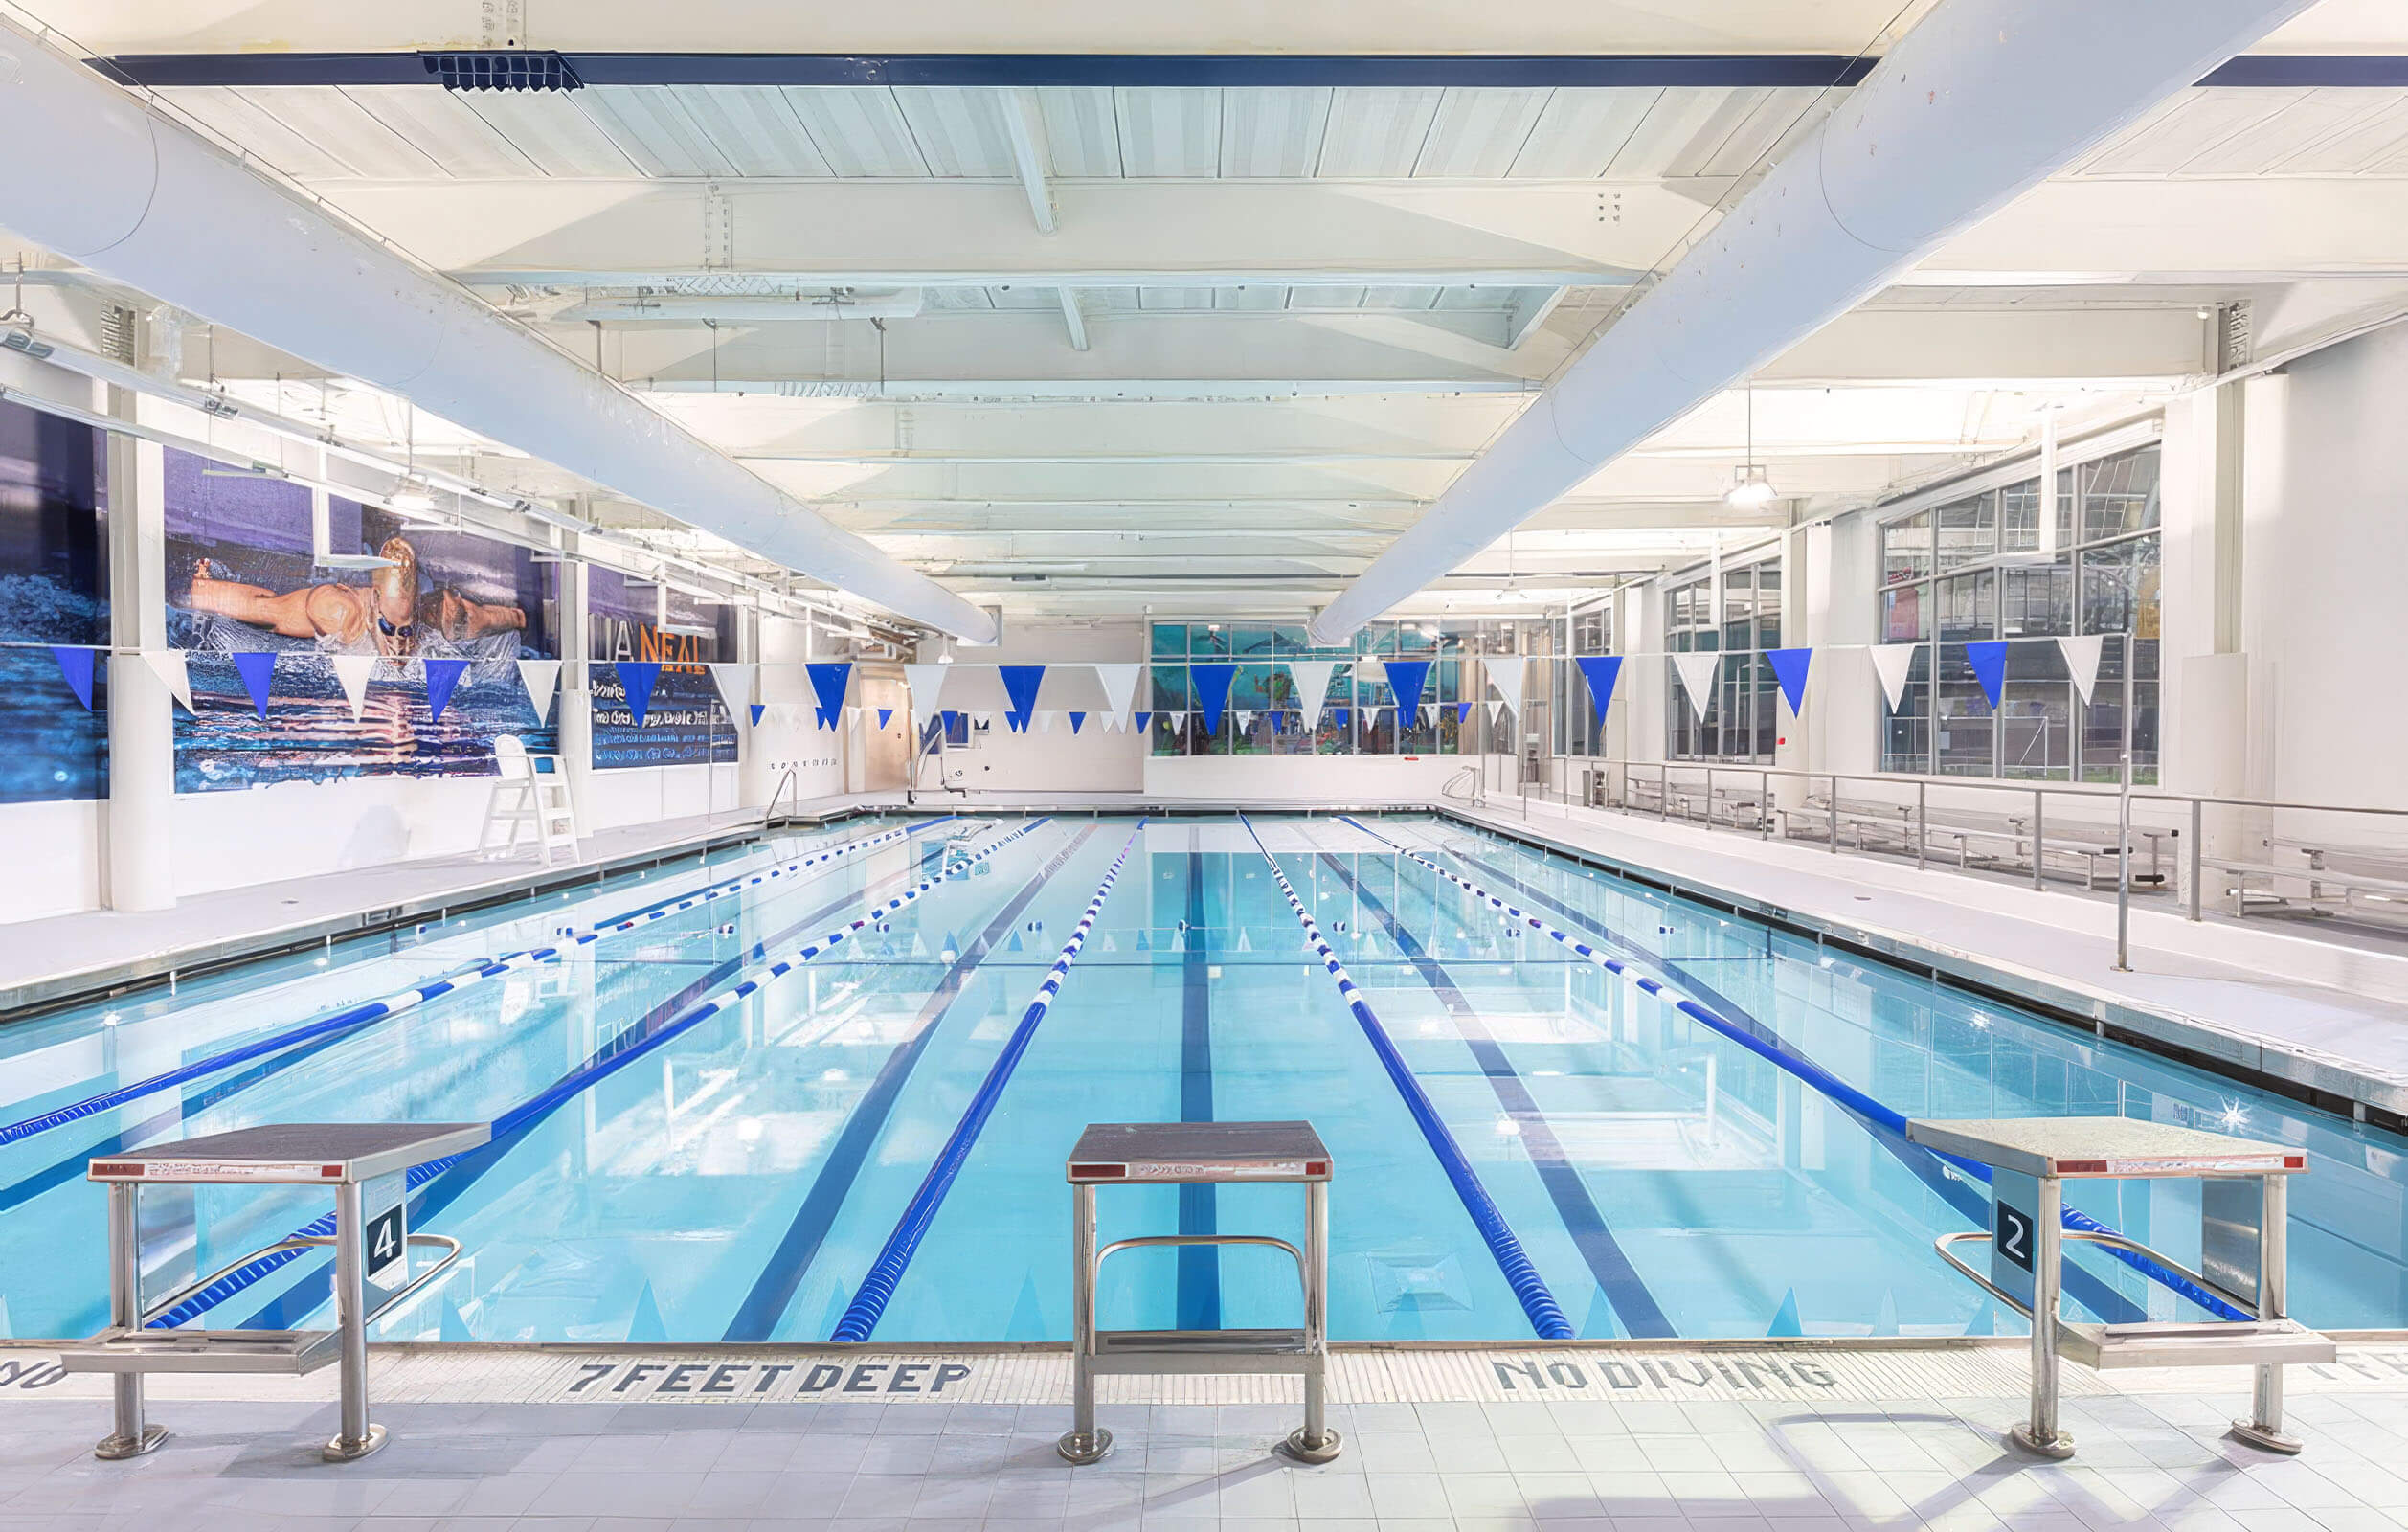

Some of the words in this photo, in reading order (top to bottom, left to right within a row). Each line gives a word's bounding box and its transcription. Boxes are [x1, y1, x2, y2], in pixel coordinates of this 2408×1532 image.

[374, 1217, 397, 1258] 4
[2005, 1214, 2026, 1259] 2
[568, 1363, 616, 1393] 7
[613, 1363, 794, 1393] FEET
[798, 1363, 973, 1393] DEEP
[1492, 1361, 1587, 1390] NO
[1597, 1359, 1838, 1390] DIVING
